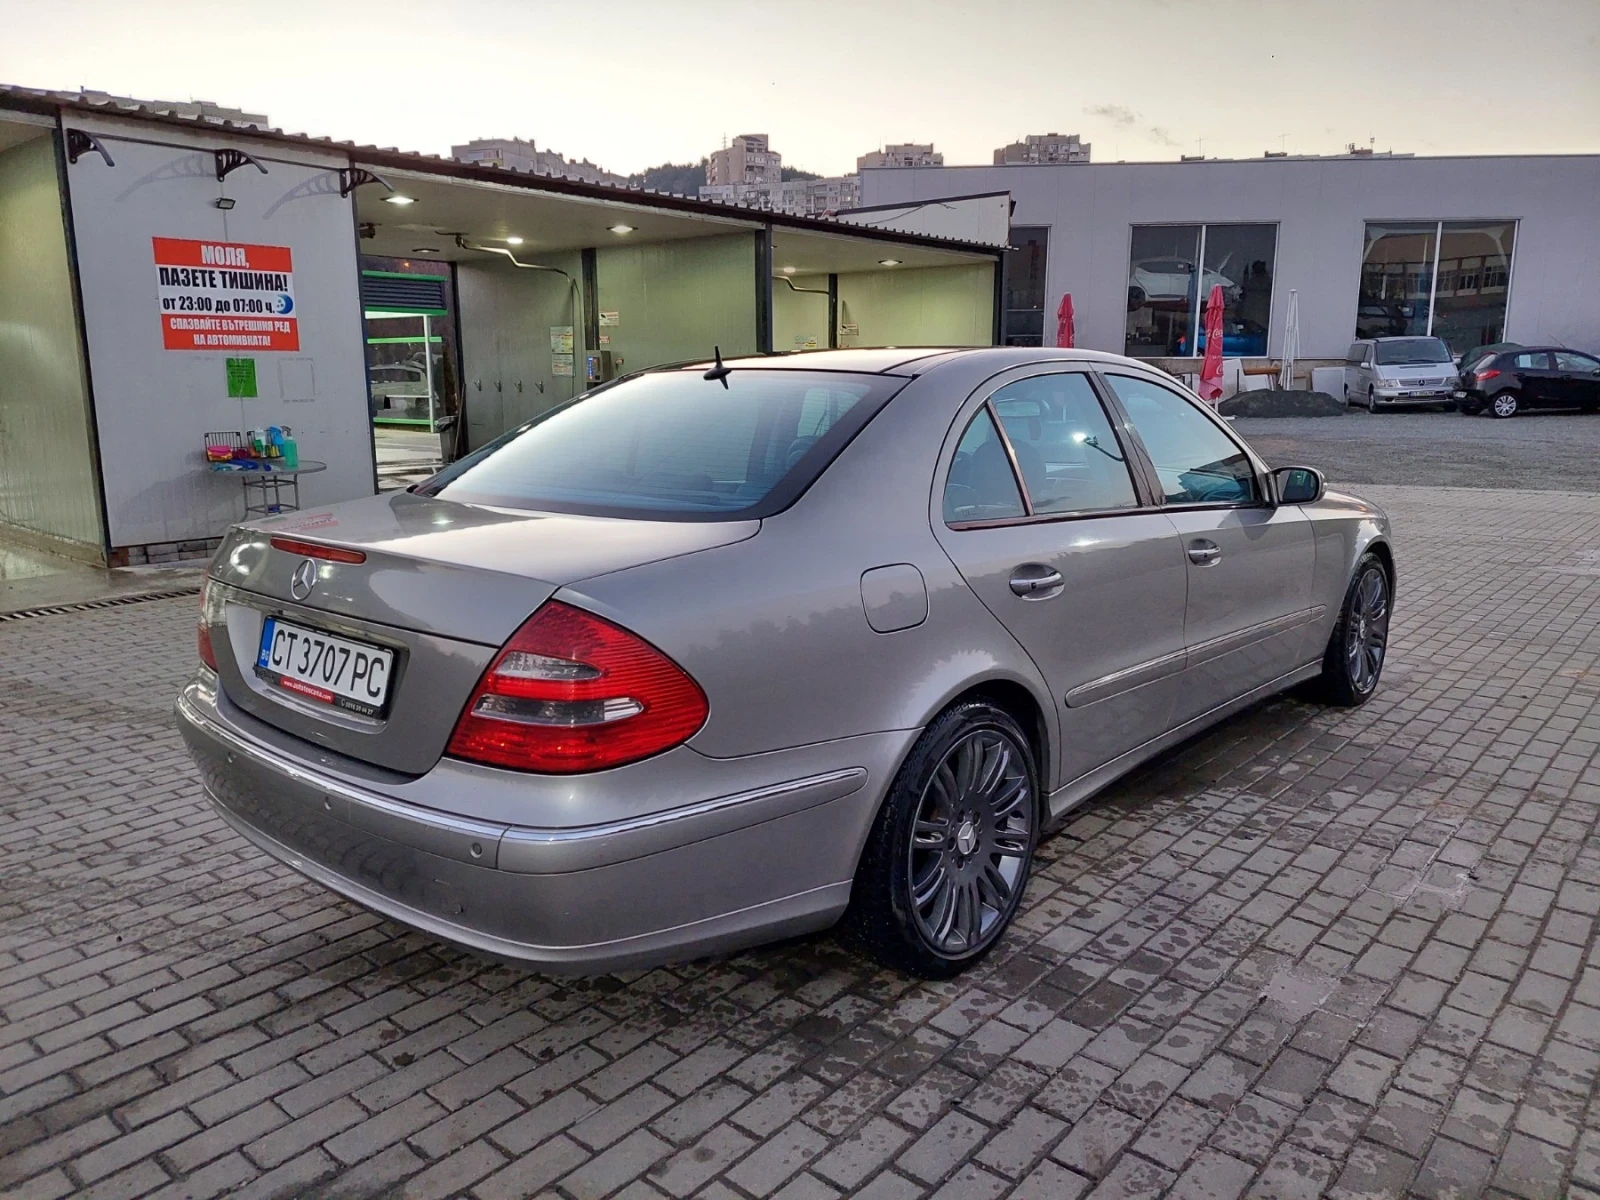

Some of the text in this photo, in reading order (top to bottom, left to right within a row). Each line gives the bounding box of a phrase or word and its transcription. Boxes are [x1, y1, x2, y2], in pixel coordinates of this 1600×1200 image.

[200, 245, 250, 268] МОЛЯ,
[159, 267, 288, 292] ПАЗЕТЕ ТИШИНА!
[163, 296, 275, 313] от 23:00 до 07:00 ч.
[170, 317, 291, 333] СПАЗВАЙТЕ ВЪТРЕШНИЯ РЕД
[193, 333, 271, 346] НА АВТОМИВКАТА!
[261, 649, 270, 661] BG
[297, 637, 351, 686] 3707
